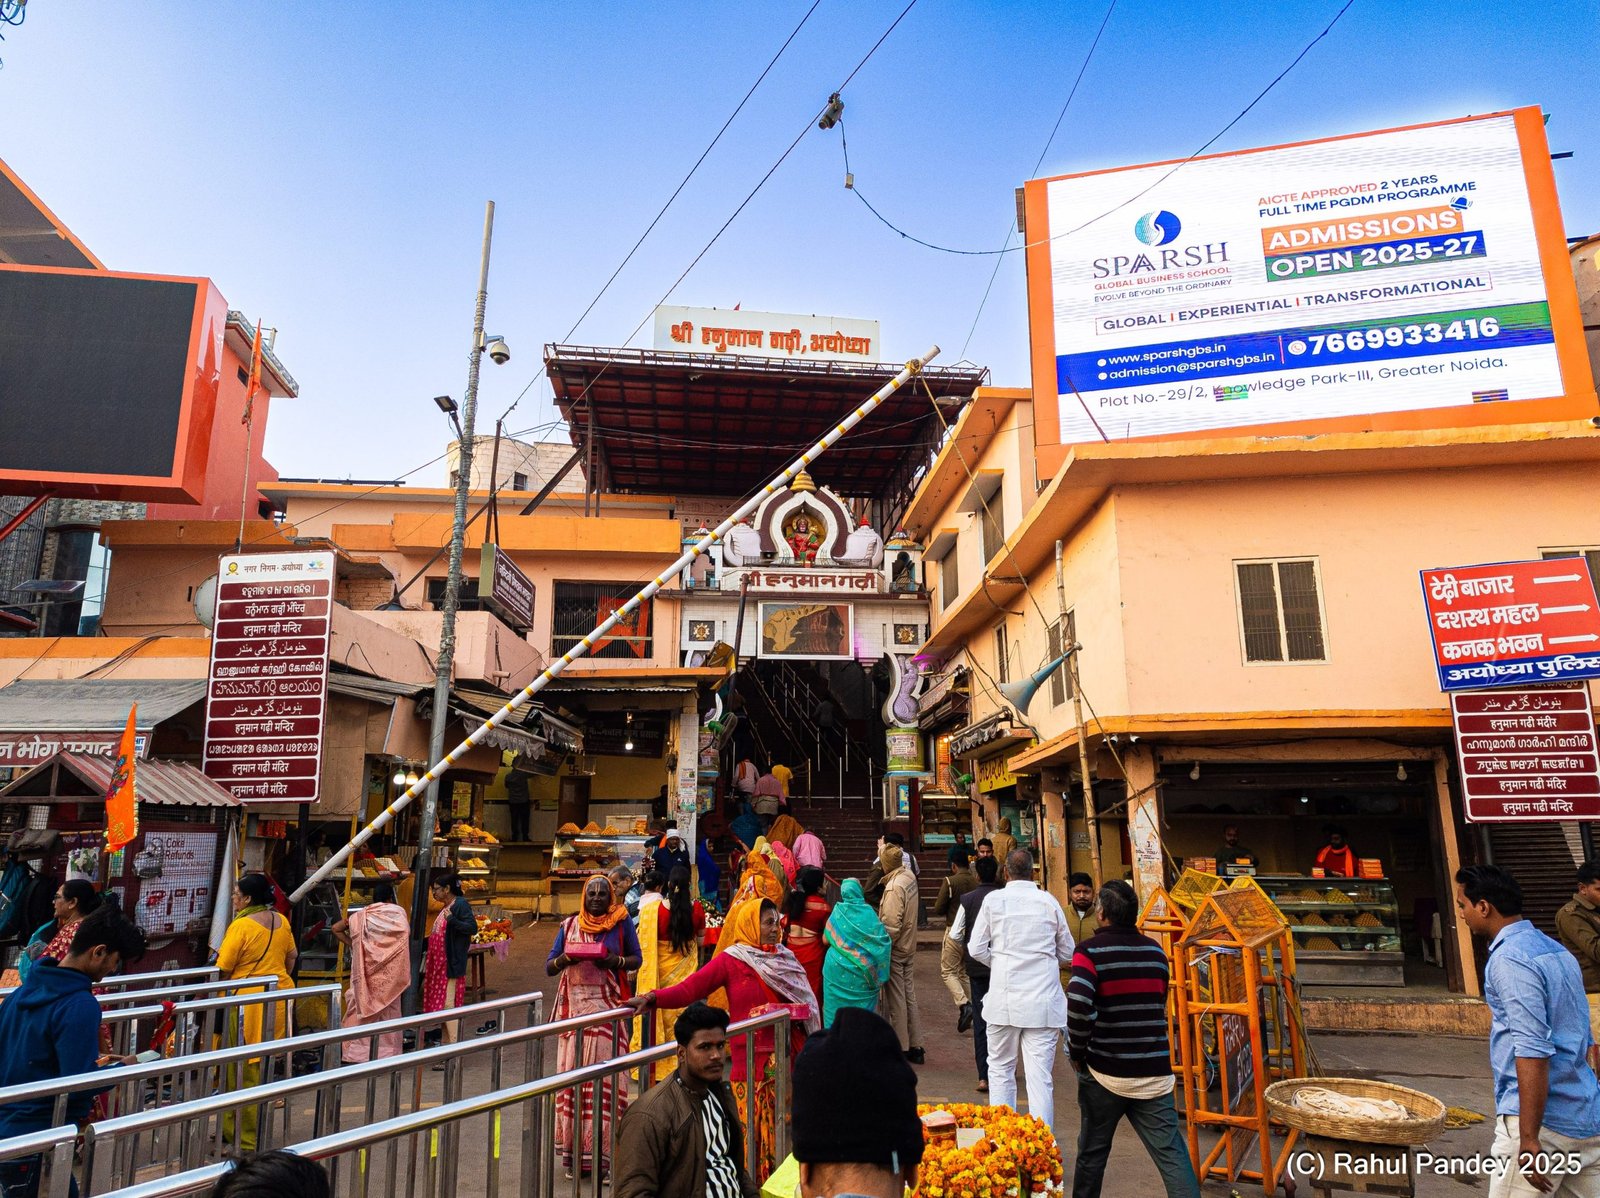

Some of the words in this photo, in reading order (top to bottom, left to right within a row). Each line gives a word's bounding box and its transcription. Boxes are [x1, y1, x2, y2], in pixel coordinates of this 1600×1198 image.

[1258, 192, 1298, 206] AICTE
[1301, 183, 1378, 201] APPROVED
[1380, 181, 1387, 190] 2
[1392, 175, 1438, 188] YEARS
[1259, 207, 1291, 217] FULL
[1294, 201, 1326, 212] TIME
[1330, 196, 1374, 209] PGDM
[1378, 181, 1476, 202] PROGRAMME
[1270, 211, 1457, 249] ADMISSIONS
[1093, 242, 1230, 278] SPARSH
[1271, 252, 1353, 276] OPEN
[1361, 236, 1477, 267] 2025-27
[1095, 280, 1134, 290] GLOBAL
[1137, 273, 1184, 285] BUSINESS
[1188, 267, 1231, 278] SCHOOL
[1095, 293, 1126, 302] EVOLVE
[1129, 288, 1164, 298] BEYOND
[1186, 279, 1232, 290] ORDINARY
[1104, 314, 1166, 330] GLOBAL
[1179, 299, 1292, 321] EXPERIENTIAL
[1304, 277, 1486, 306] TRANSFORMATIONAL
[670, 321, 693, 344] श्री
[702, 327, 763, 352] हनुमान
[810, 331, 871, 355] अयोध्या
[1308, 317, 1500, 355] 7669933416
[1109, 343, 1226, 364] www.sparshgbs.in
[1110, 352, 1275, 379] admission@sparshgbs.in
[1100, 395, 1128, 408] Plot
[1312, 370, 1373, 386] Park-III,
[1378, 364, 1444, 379] Greater
[1451, 357, 1507, 372] Noida.
[763, 574, 837, 588] हनुमान
[1459, 576, 1514, 596] बाजार
[1435, 608, 1490, 629] दशरथ
[1491, 603, 1539, 624] महल
[243, 625, 266, 636] हनुमान
[282, 621, 302, 633] मन्दिर
[1441, 639, 1495, 659] कनक
[1497, 634, 1544, 654] भवन
[1448, 663, 1534, 680] अयोध्या
[235, 724, 259, 735] हनुमान
[275, 720, 295, 732] मन्दिर
[1490, 719, 1518, 731] हनुमान
[16, 735, 60, 758] भोग
[232, 764, 256, 775] हनुमान
[1499, 780, 1527, 792] हनुमान
[1502, 803, 1530, 815] हनुमान
[1550, 799, 1573, 812] मन्दिर
